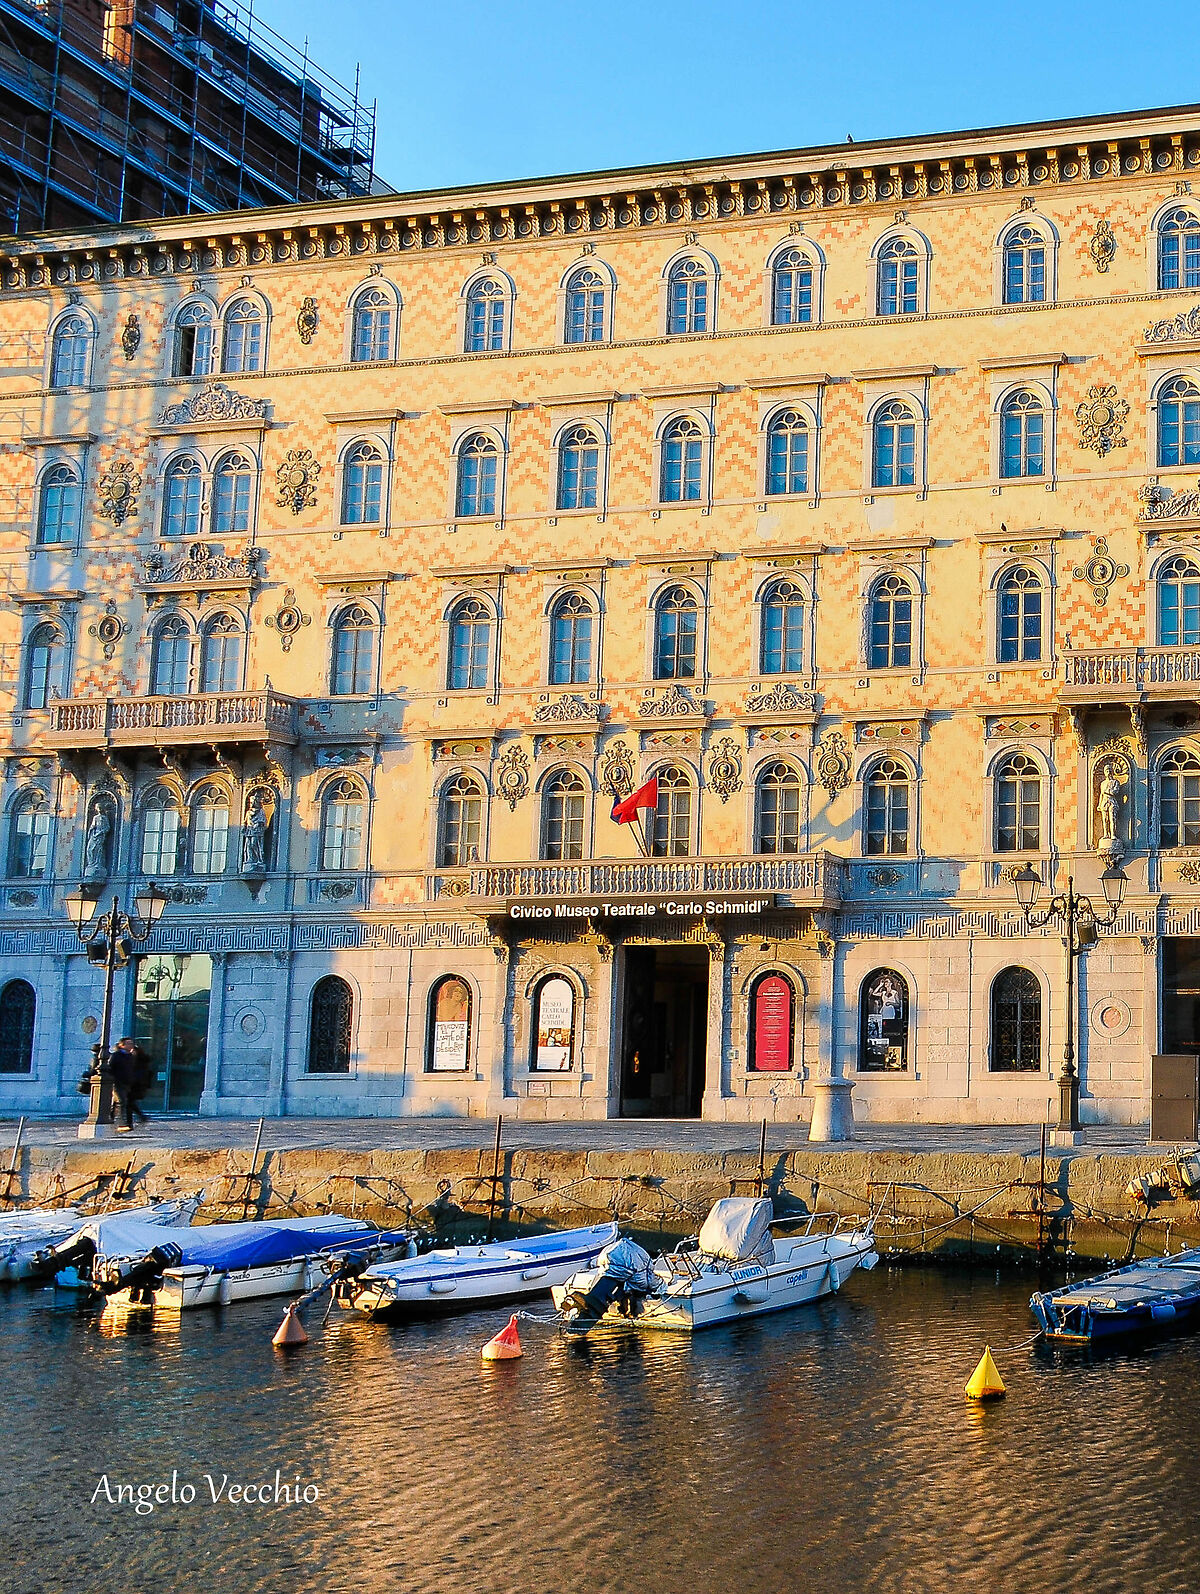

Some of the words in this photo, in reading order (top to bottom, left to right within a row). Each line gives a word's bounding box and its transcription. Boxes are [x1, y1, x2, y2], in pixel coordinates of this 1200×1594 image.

[510, 905, 551, 919] Civico
[555, 904, 599, 918] Museo
[602, 902, 656, 917] Teatrale
[732, 1266, 763, 1281] JUNIOR
